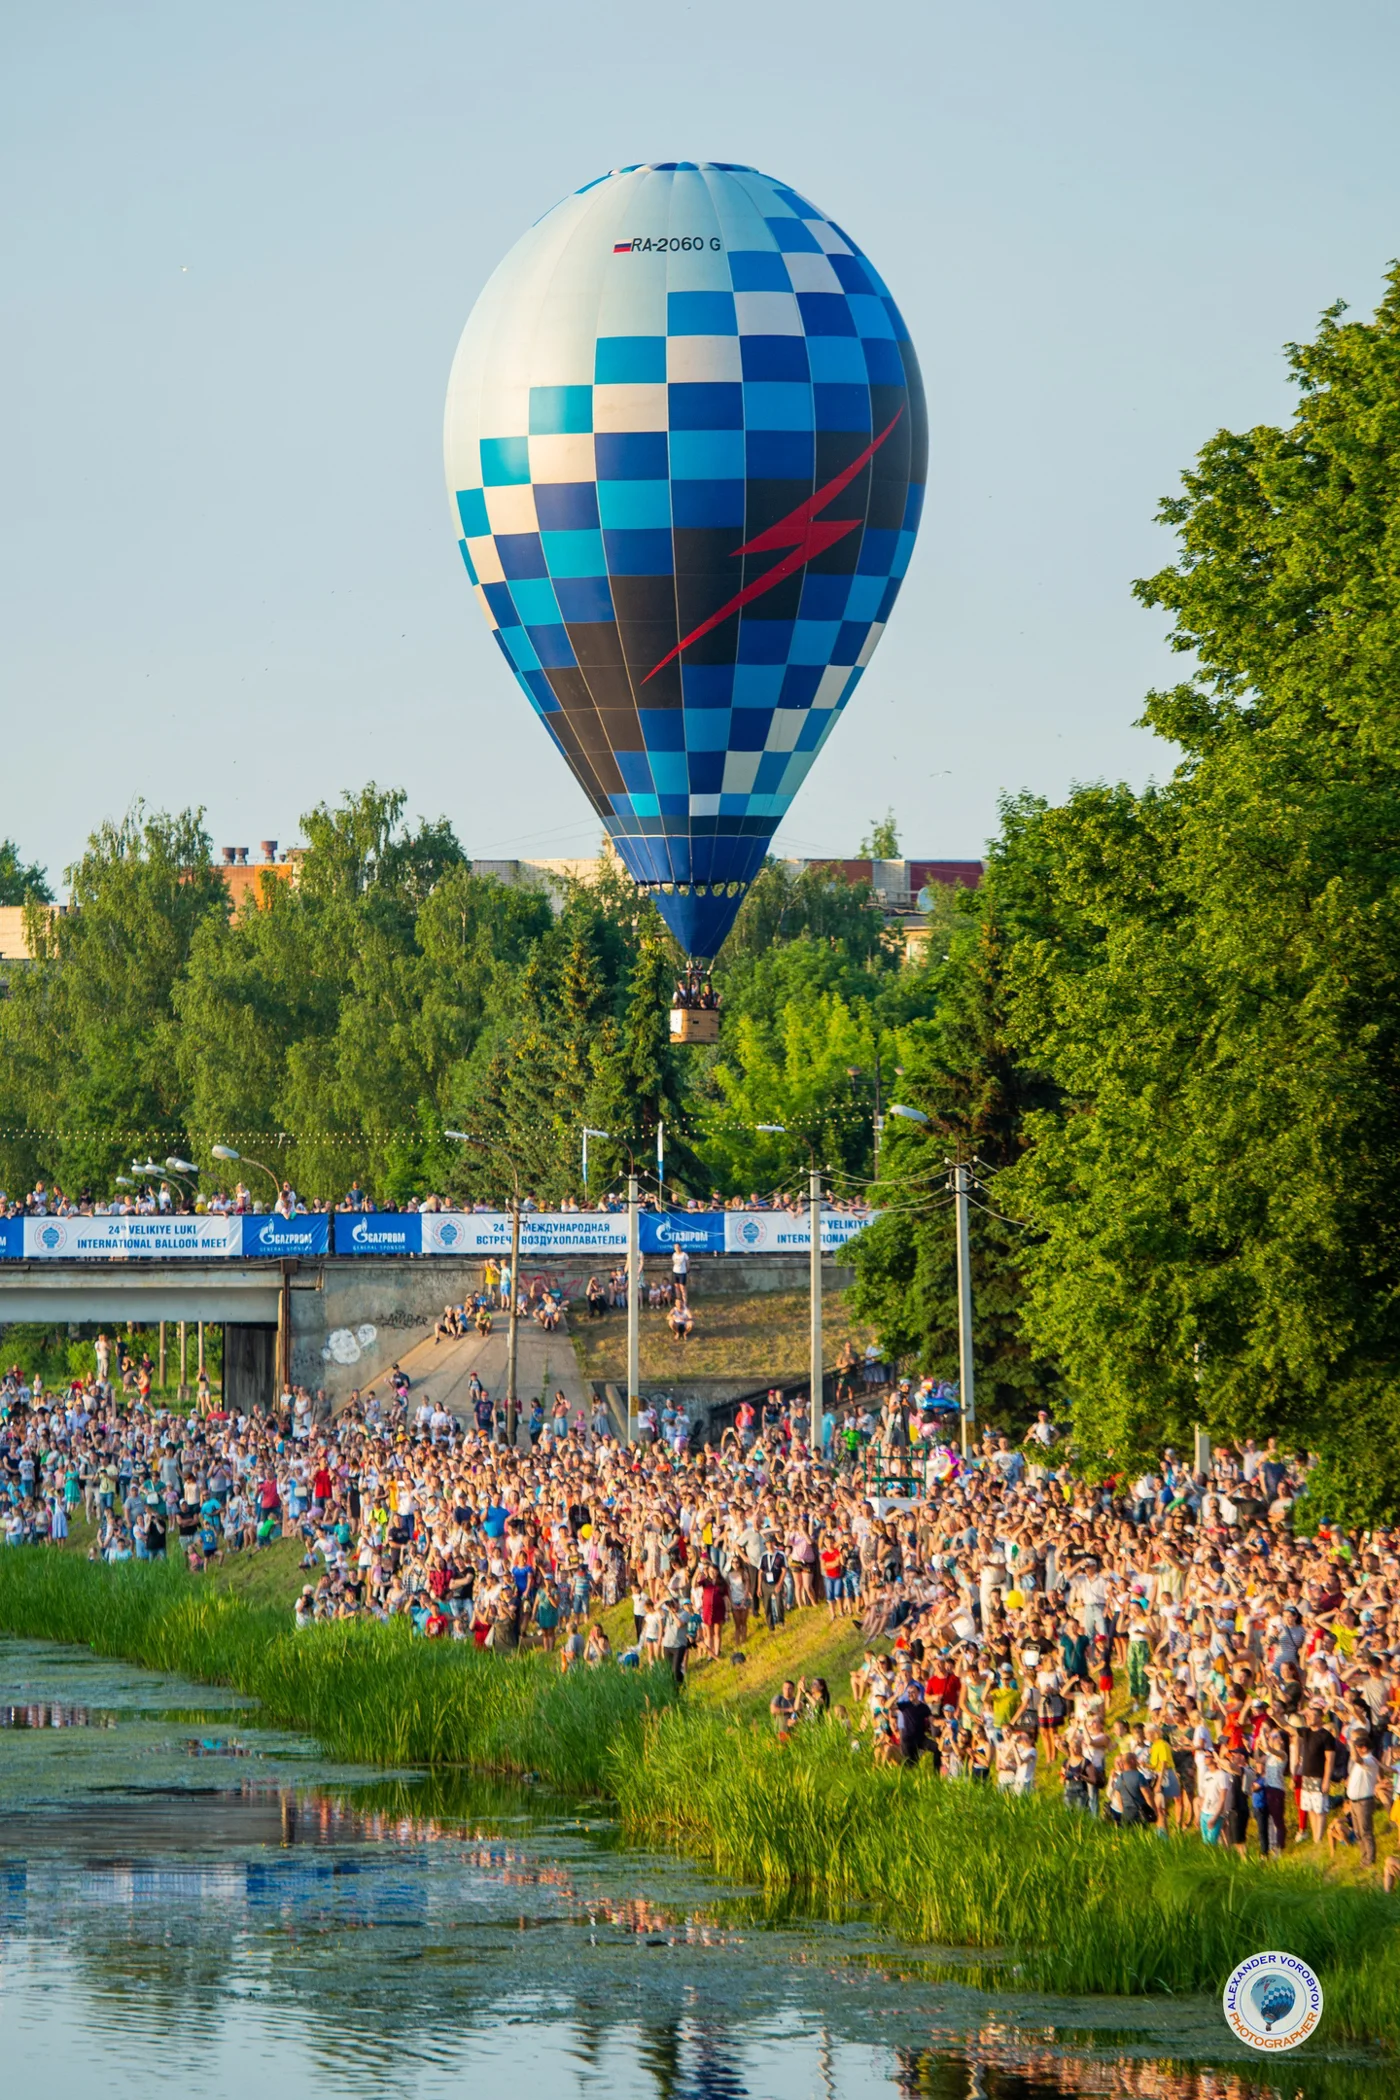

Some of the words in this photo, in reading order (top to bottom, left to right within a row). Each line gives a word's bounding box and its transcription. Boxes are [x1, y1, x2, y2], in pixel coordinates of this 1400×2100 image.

[631, 236, 704, 252] RA-2060
[709, 237, 721, 251] G
[128, 1225, 171, 1235] VELIKIYE
[174, 1225, 197, 1235] LUKI
[493, 1223, 505, 1233] 24
[522, 1223, 610, 1234] МЕЖДУНАРОДНАЯ
[274, 1233, 312, 1244] GAZPROM
[367, 1232, 406, 1243] GAZPROM
[476, 1235, 513, 1245] ВСТРЕЧ
[521, 1234, 628, 1246] ВОЗДУХОПЛАВАТЕЛЕЙ
[671, 1231, 709, 1242] ГАЗПРОМ
[77, 1239, 152, 1249] INTERNATIONAL
[155, 1238, 198, 1249] BALLOON
[201, 1238, 227, 1248] MEET
